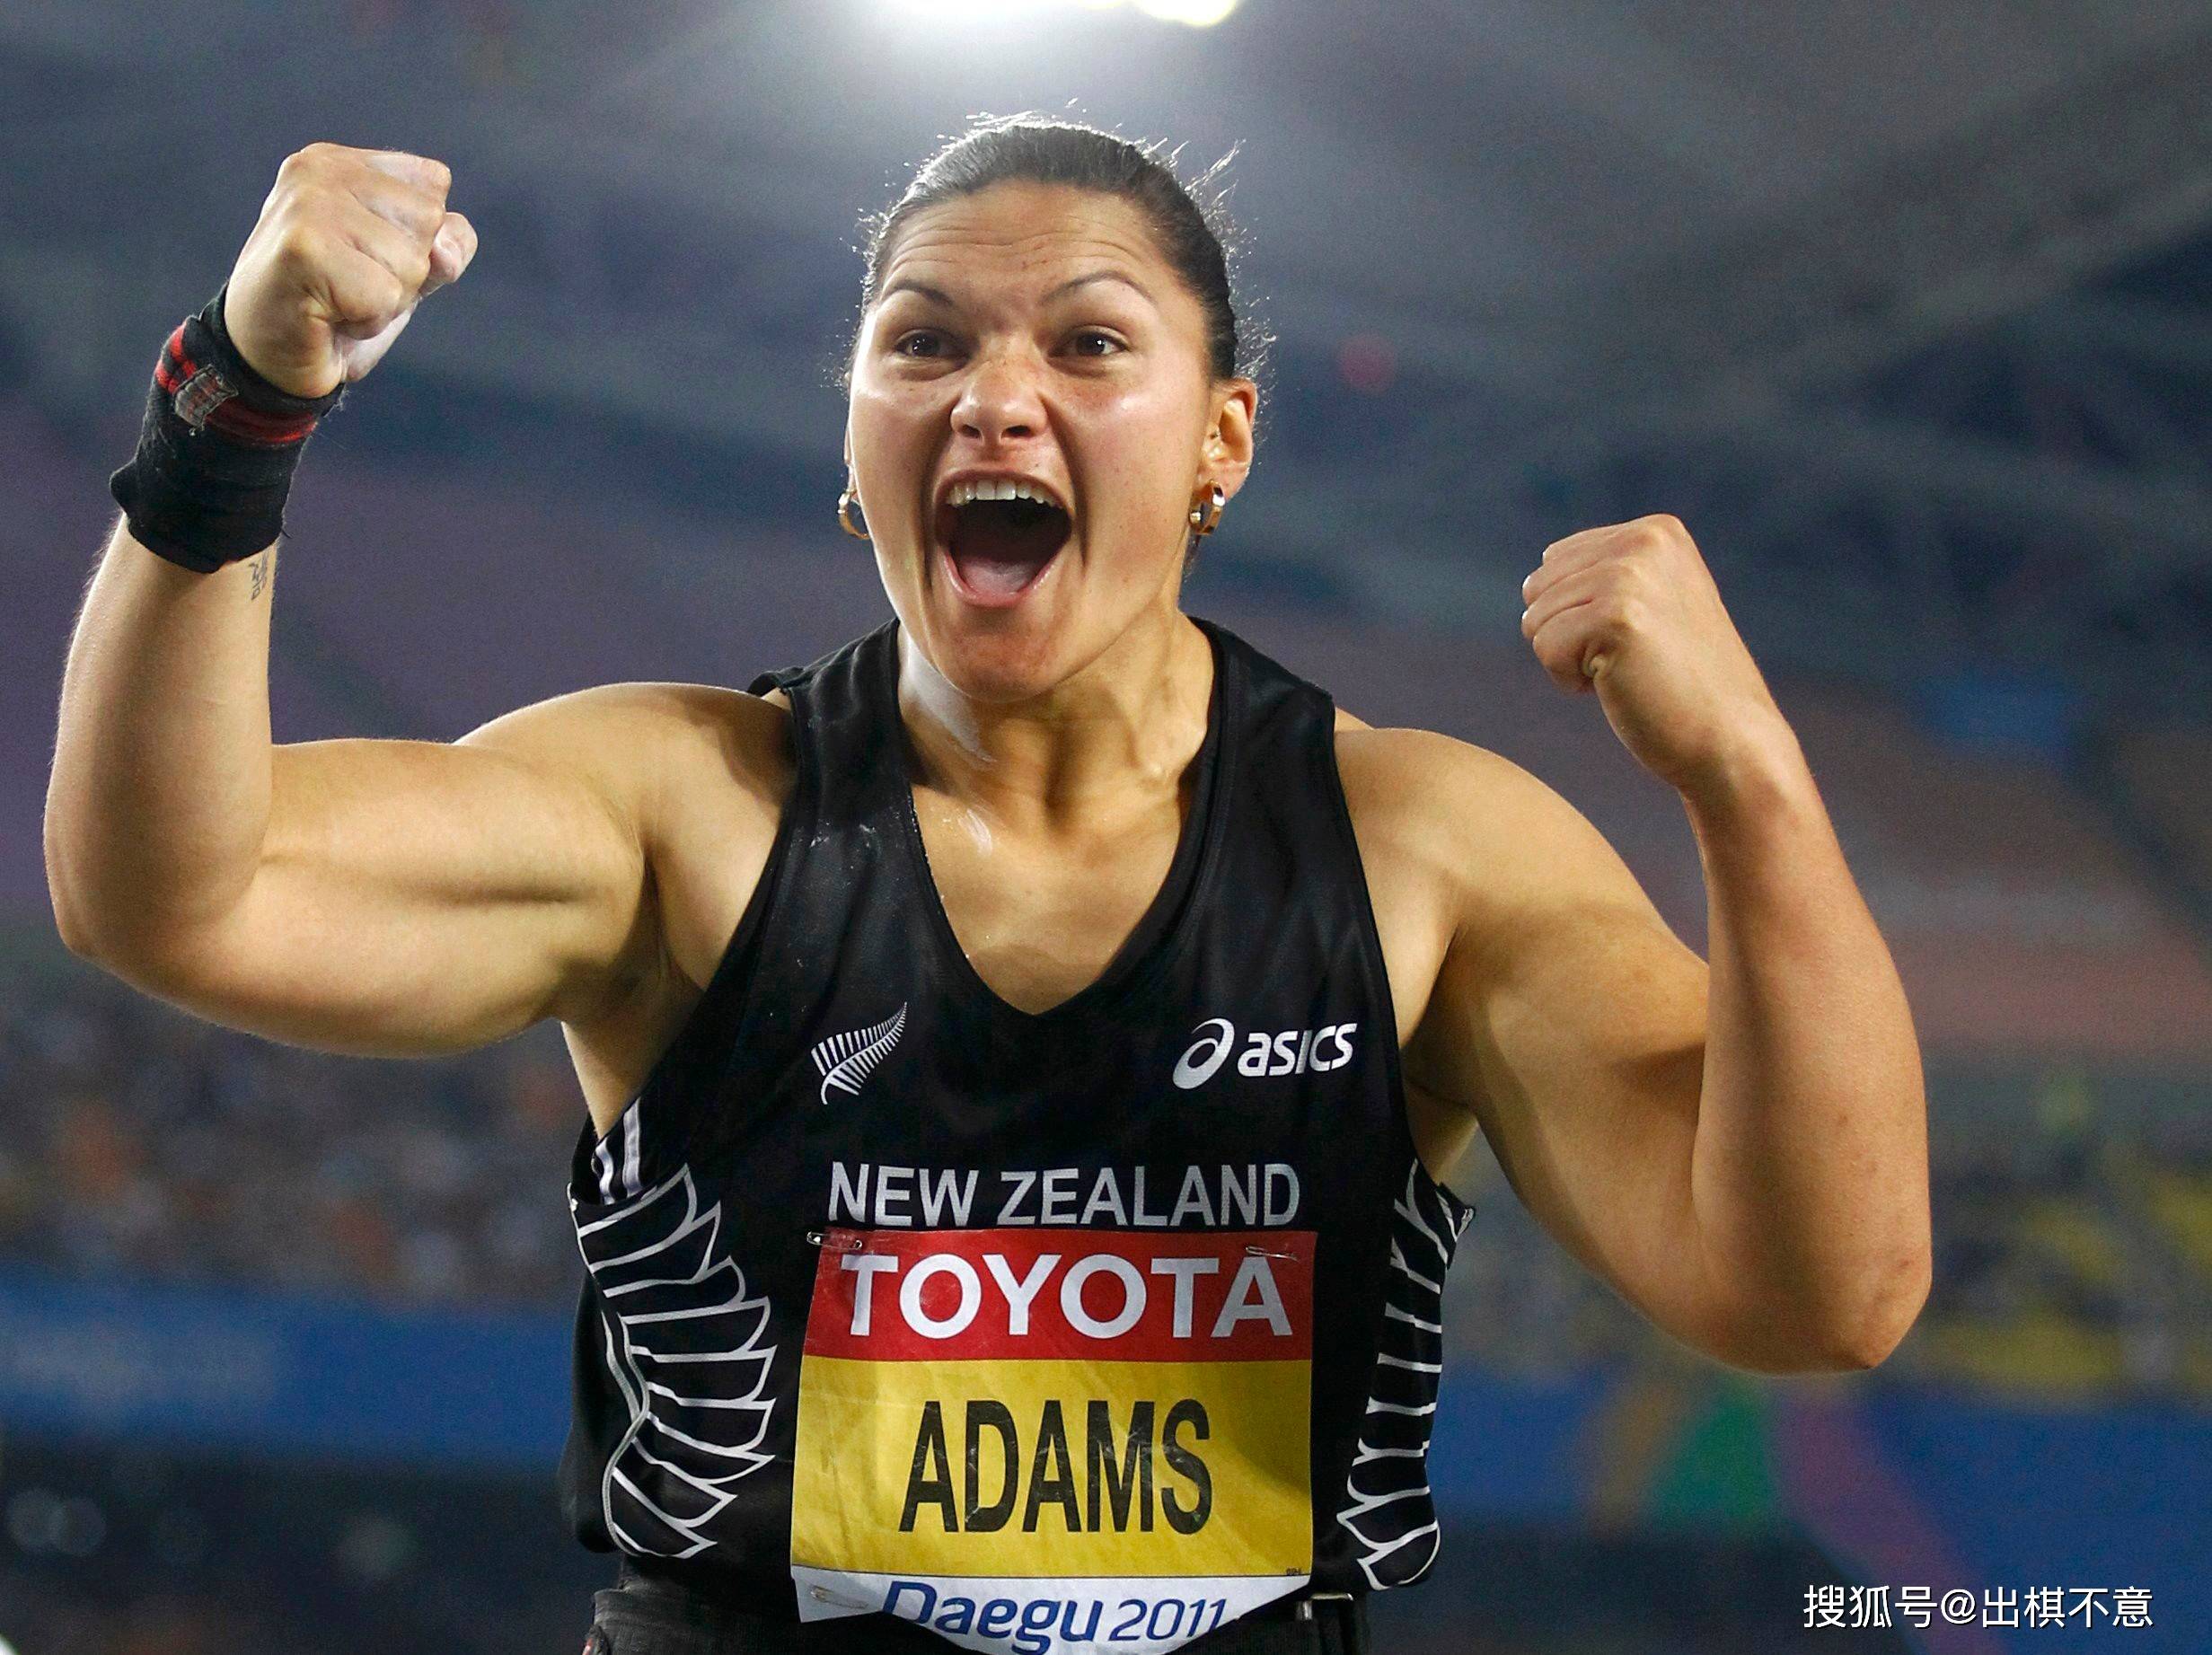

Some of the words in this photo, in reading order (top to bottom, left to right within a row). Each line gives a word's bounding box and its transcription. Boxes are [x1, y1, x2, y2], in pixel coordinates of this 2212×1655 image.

[1237, 1023, 1357, 1077] asics
[828, 1162, 979, 1227] NEW
[997, 1164, 1300, 1227] ZEALAND
[842, 1254, 1292, 1339] TOYOTA
[898, 1398, 1212, 1535] ADAMS
[882, 1580, 1103, 1655] Daegu
[1108, 1598, 1227, 1641] 2011
